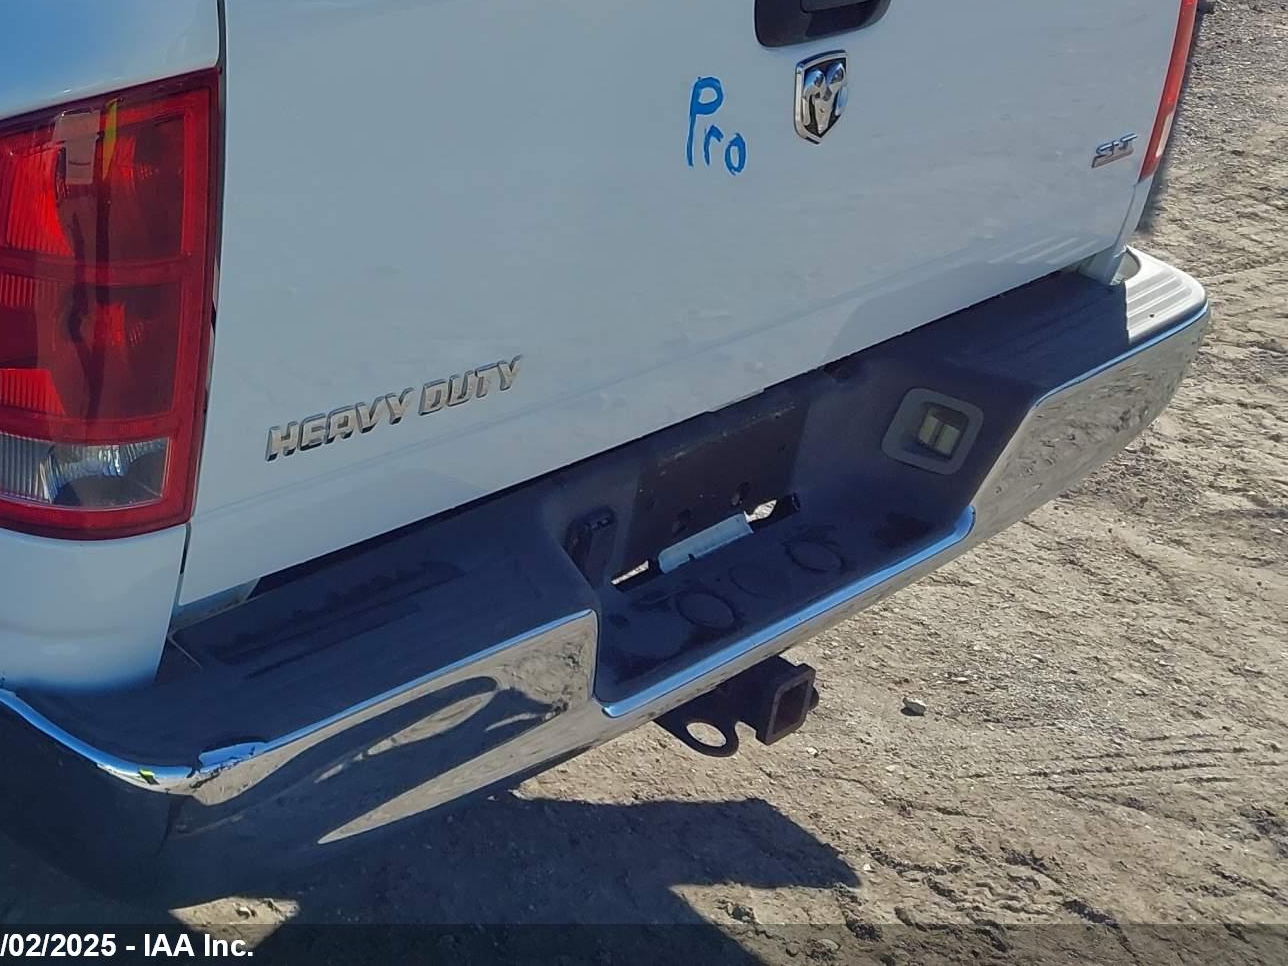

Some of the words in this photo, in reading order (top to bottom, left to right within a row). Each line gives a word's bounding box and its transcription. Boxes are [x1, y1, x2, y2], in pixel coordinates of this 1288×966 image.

[685, 75, 748, 176] Pro
[265, 387, 415, 463] HEAVY
[417, 354, 524, 417] DUTY
